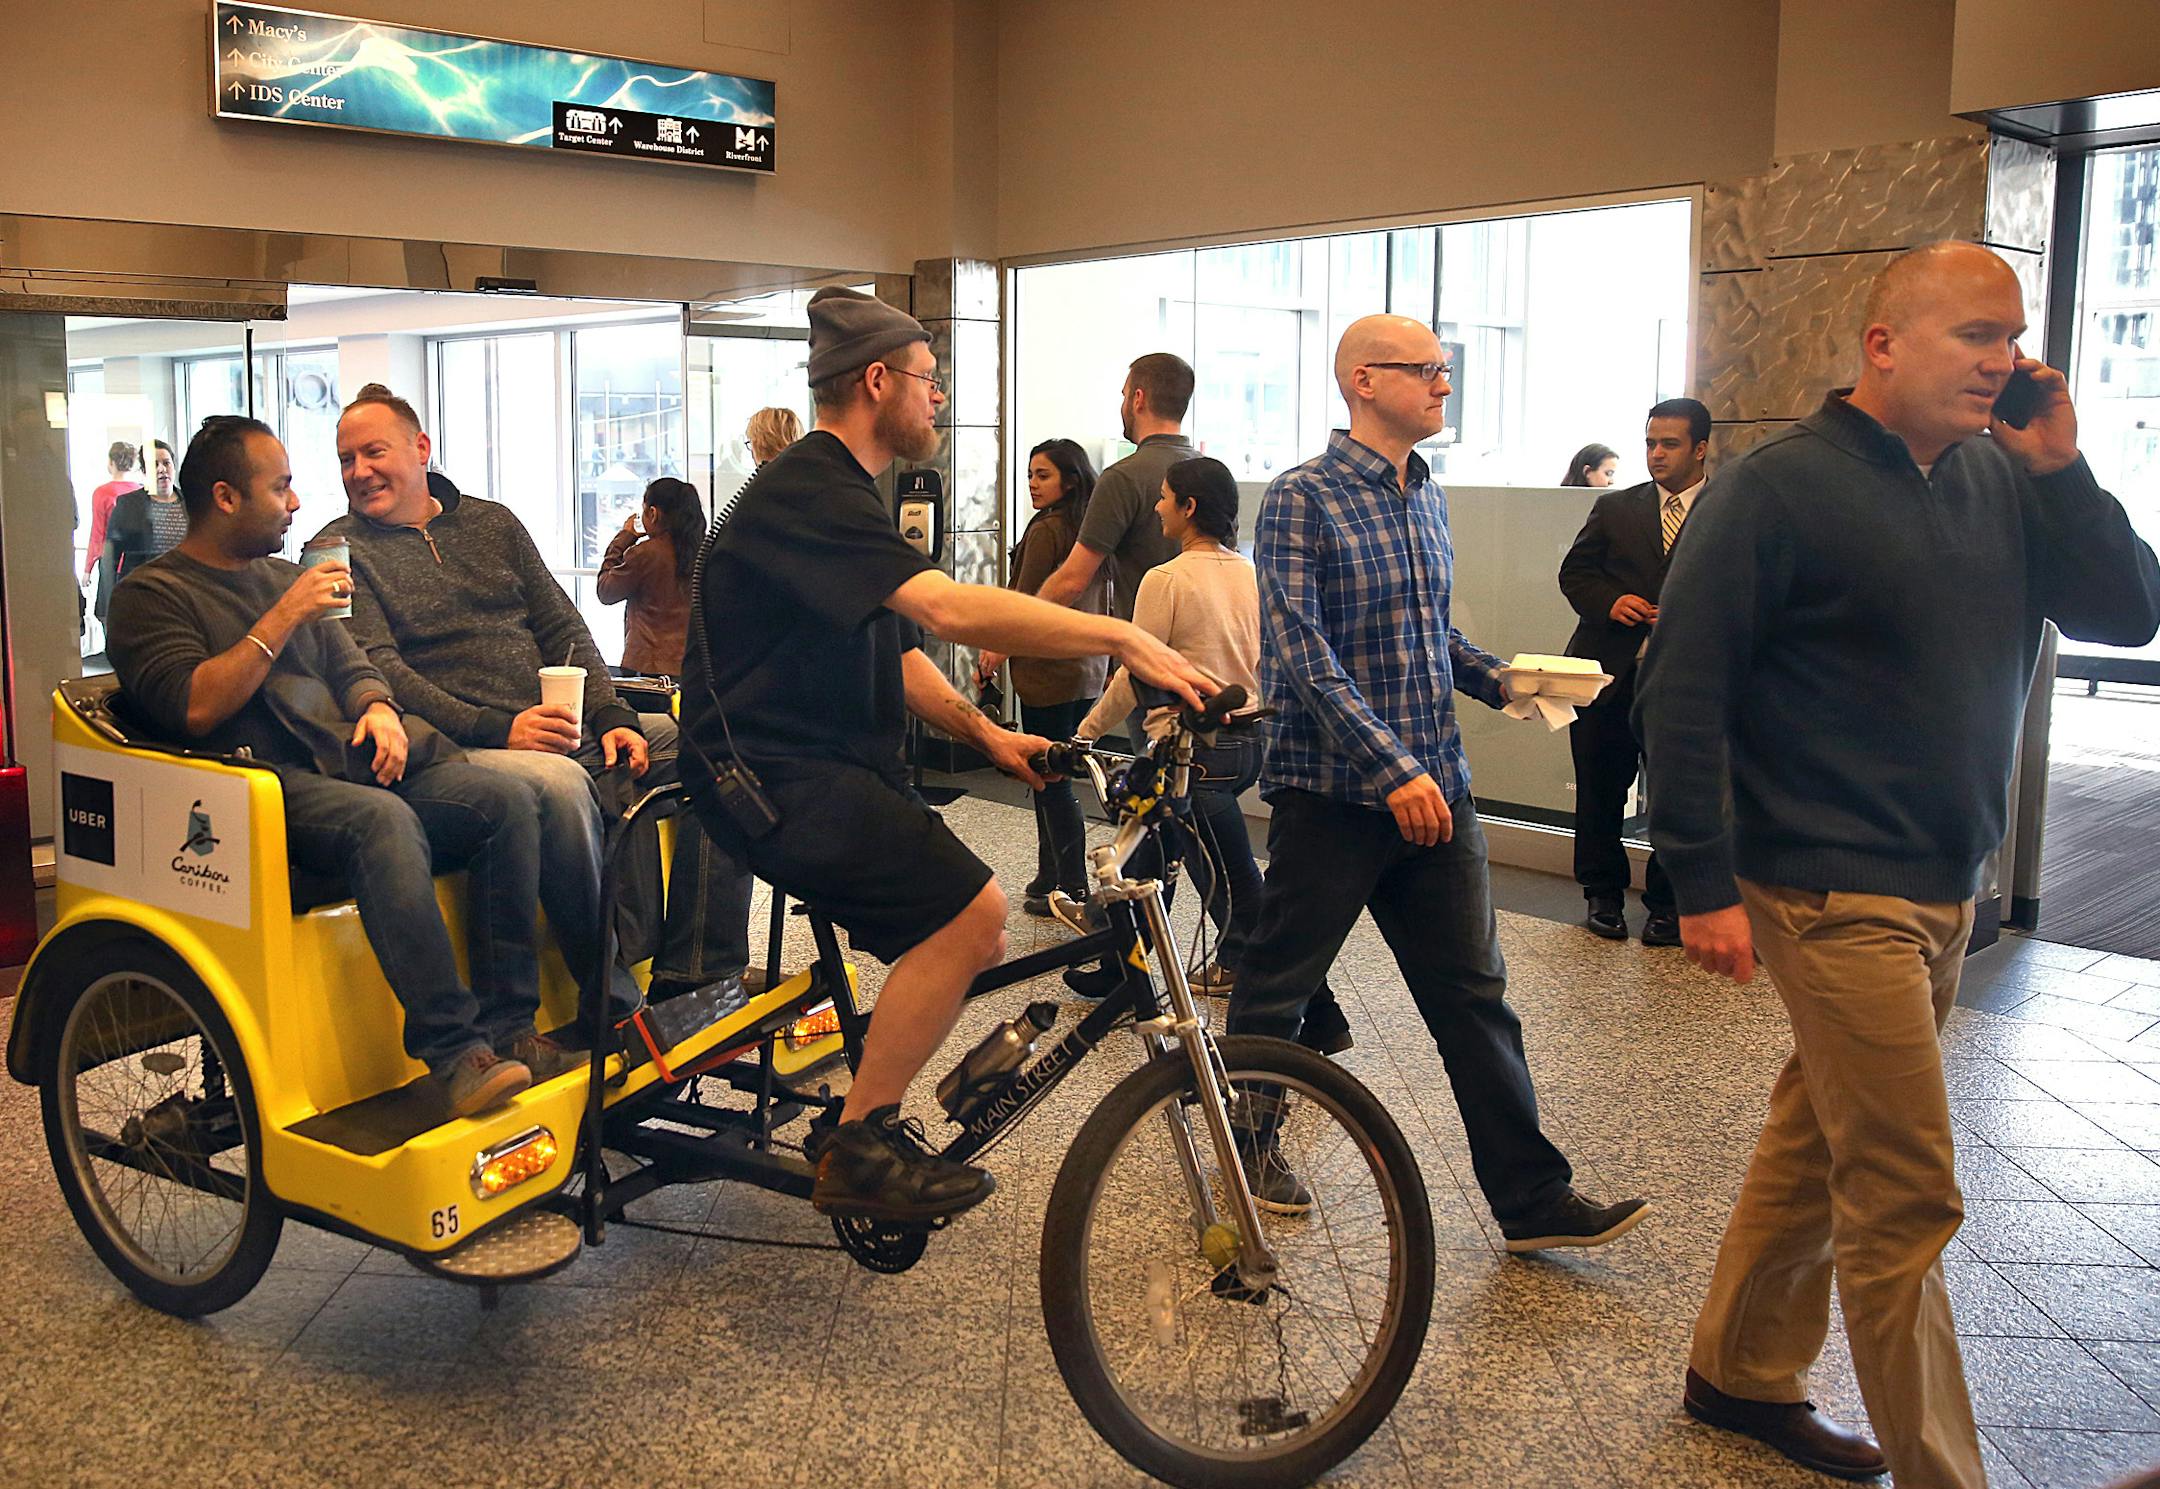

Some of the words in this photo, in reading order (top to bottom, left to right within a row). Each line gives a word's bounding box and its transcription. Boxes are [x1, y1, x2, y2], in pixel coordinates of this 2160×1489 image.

[248, 19, 307, 42] Macy's
[250, 85, 283, 103] IDS
[288, 89, 345, 110] Center
[558, 132, 584, 144] Target
[586, 135, 613, 147] Center
[633, 140, 675, 154] Warehouse
[676, 145, 704, 157] District
[725, 151, 762, 163] Riverfront
[69, 808, 106, 830] UBER
[171, 856, 230, 883] Caribou
[970, 1090, 1018, 1140] MAIN
[1016, 1040, 1073, 1098] STREET
[431, 1205, 459, 1238] 65
